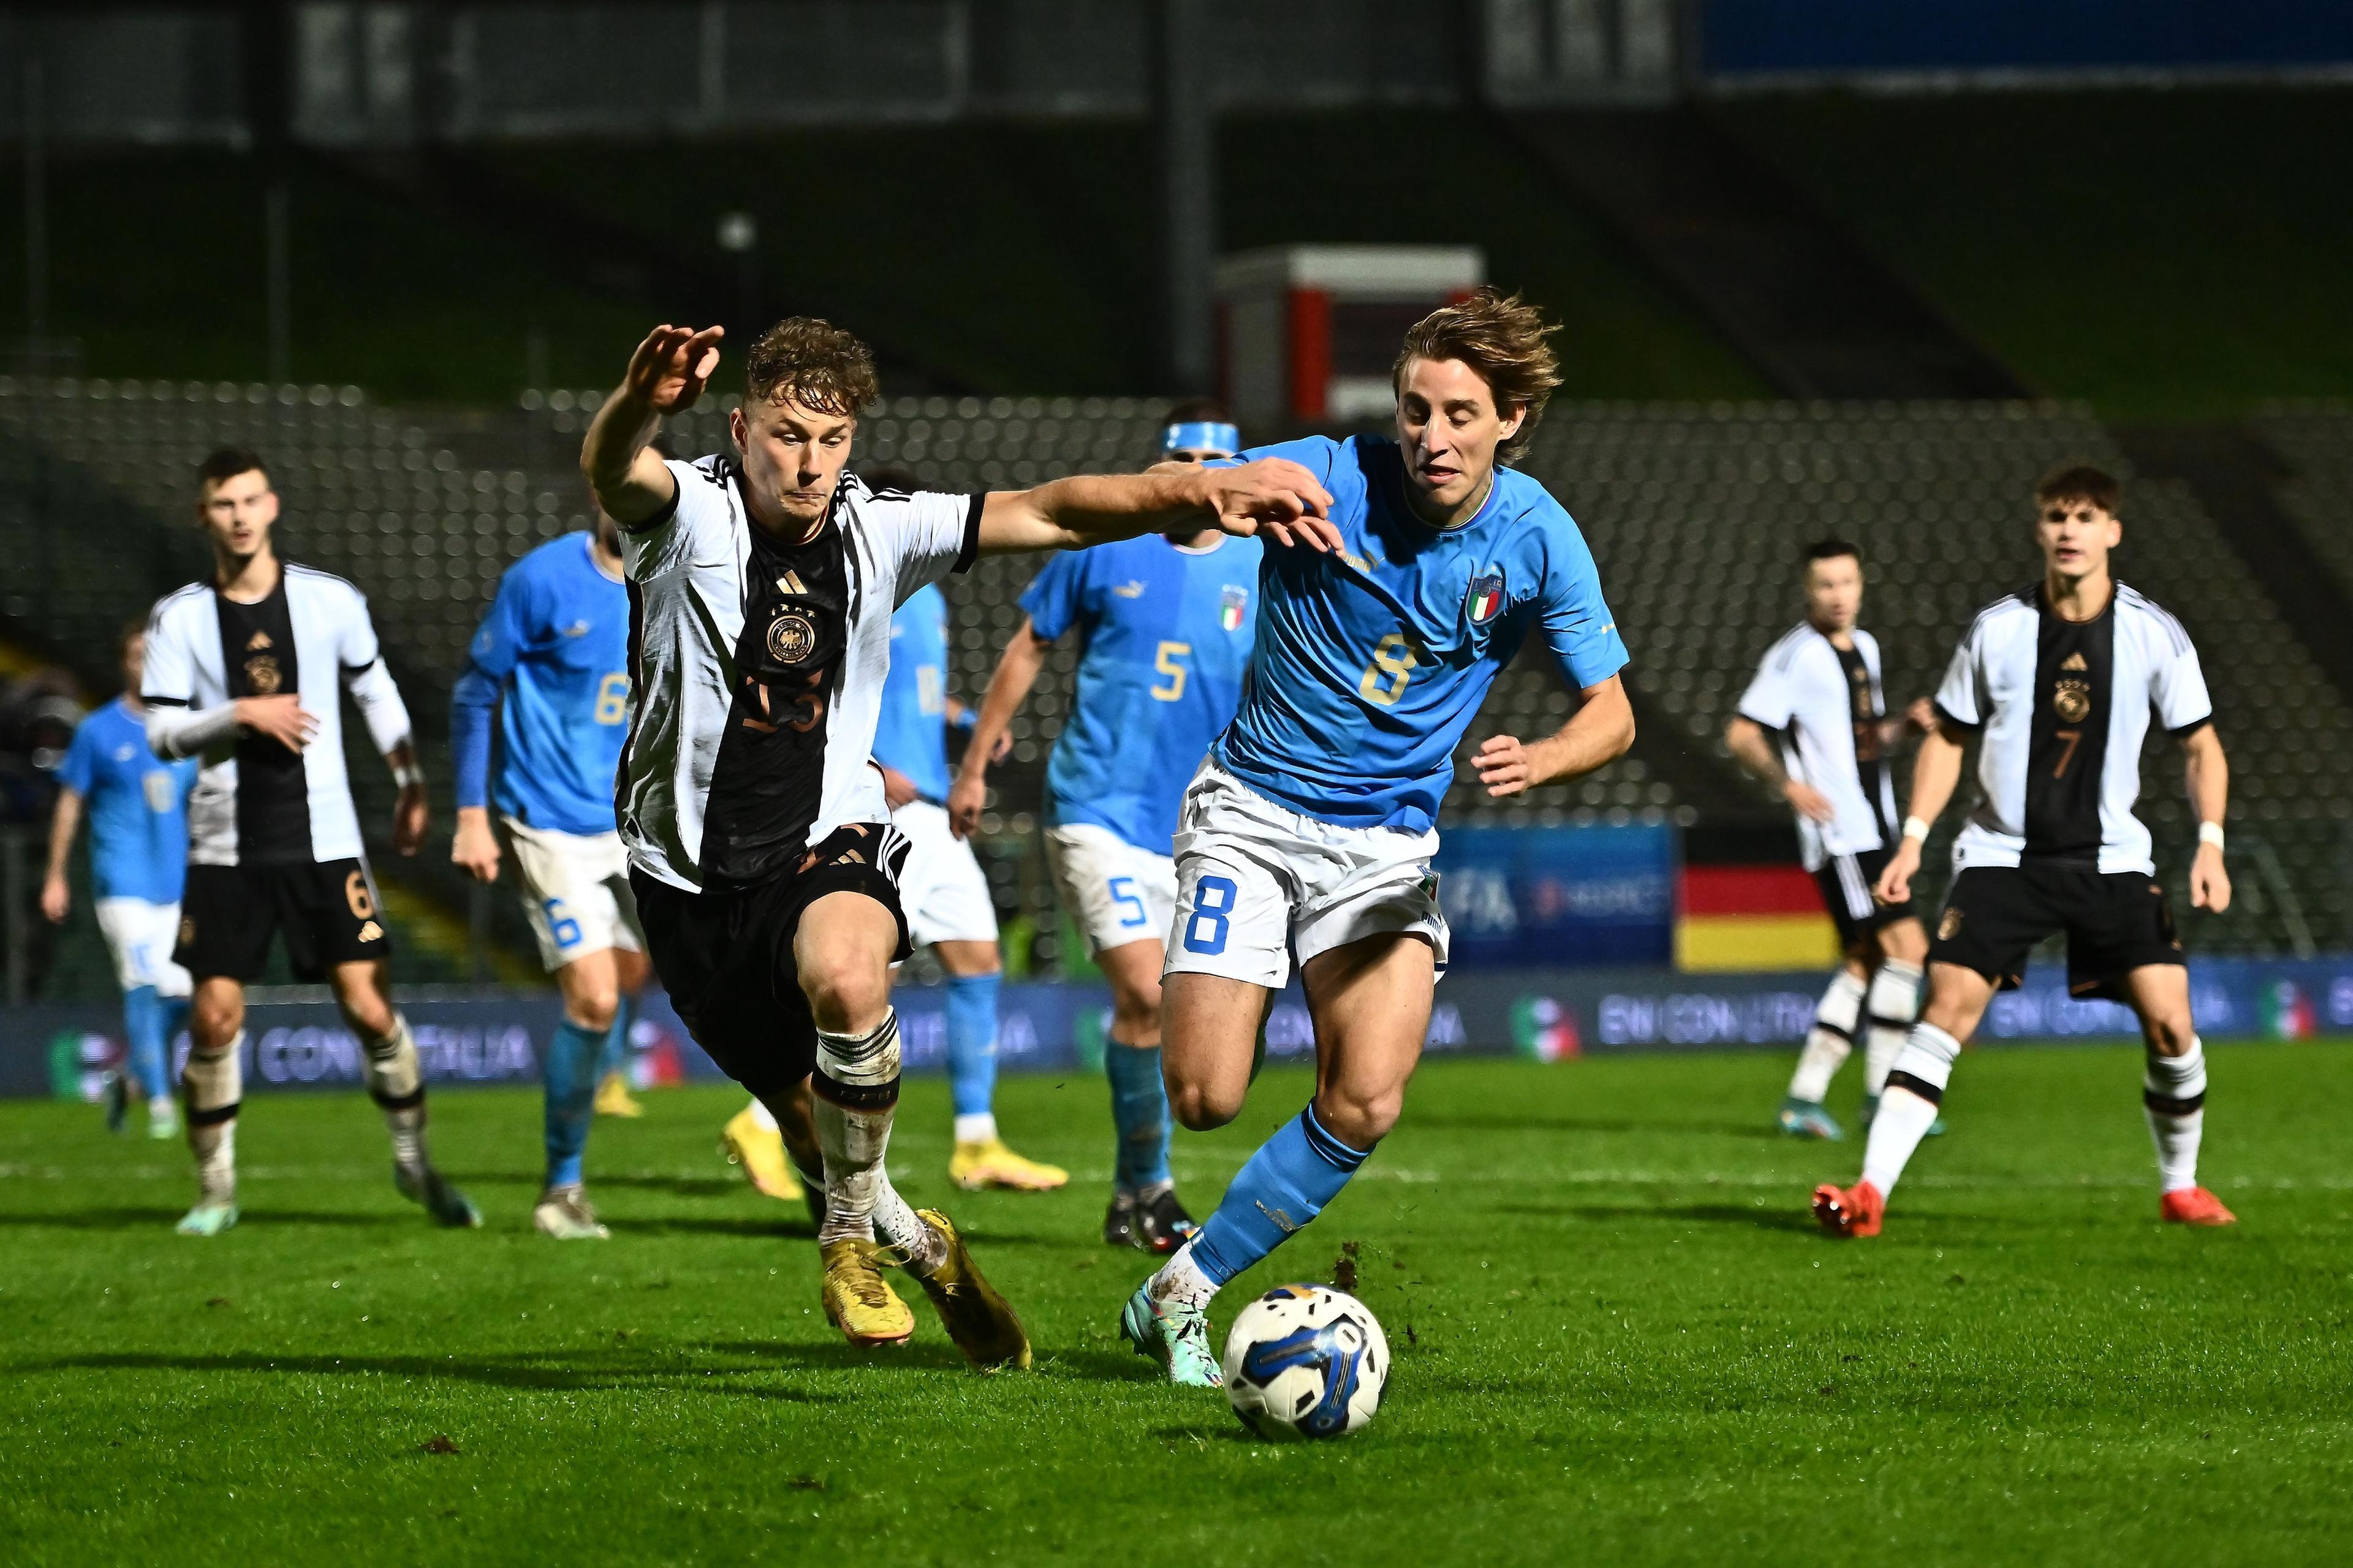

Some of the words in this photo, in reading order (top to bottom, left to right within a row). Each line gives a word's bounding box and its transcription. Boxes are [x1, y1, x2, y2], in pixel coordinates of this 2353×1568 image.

[1151, 641, 1191, 702] 5
[1358, 633, 1417, 706] 8
[594, 672, 626, 725] 6
[2053, 730, 2082, 779] 7
[344, 869, 374, 919] 6
[1107, 876, 1146, 928] 5
[1183, 875, 1238, 956] 8
[544, 897, 583, 950] 6
